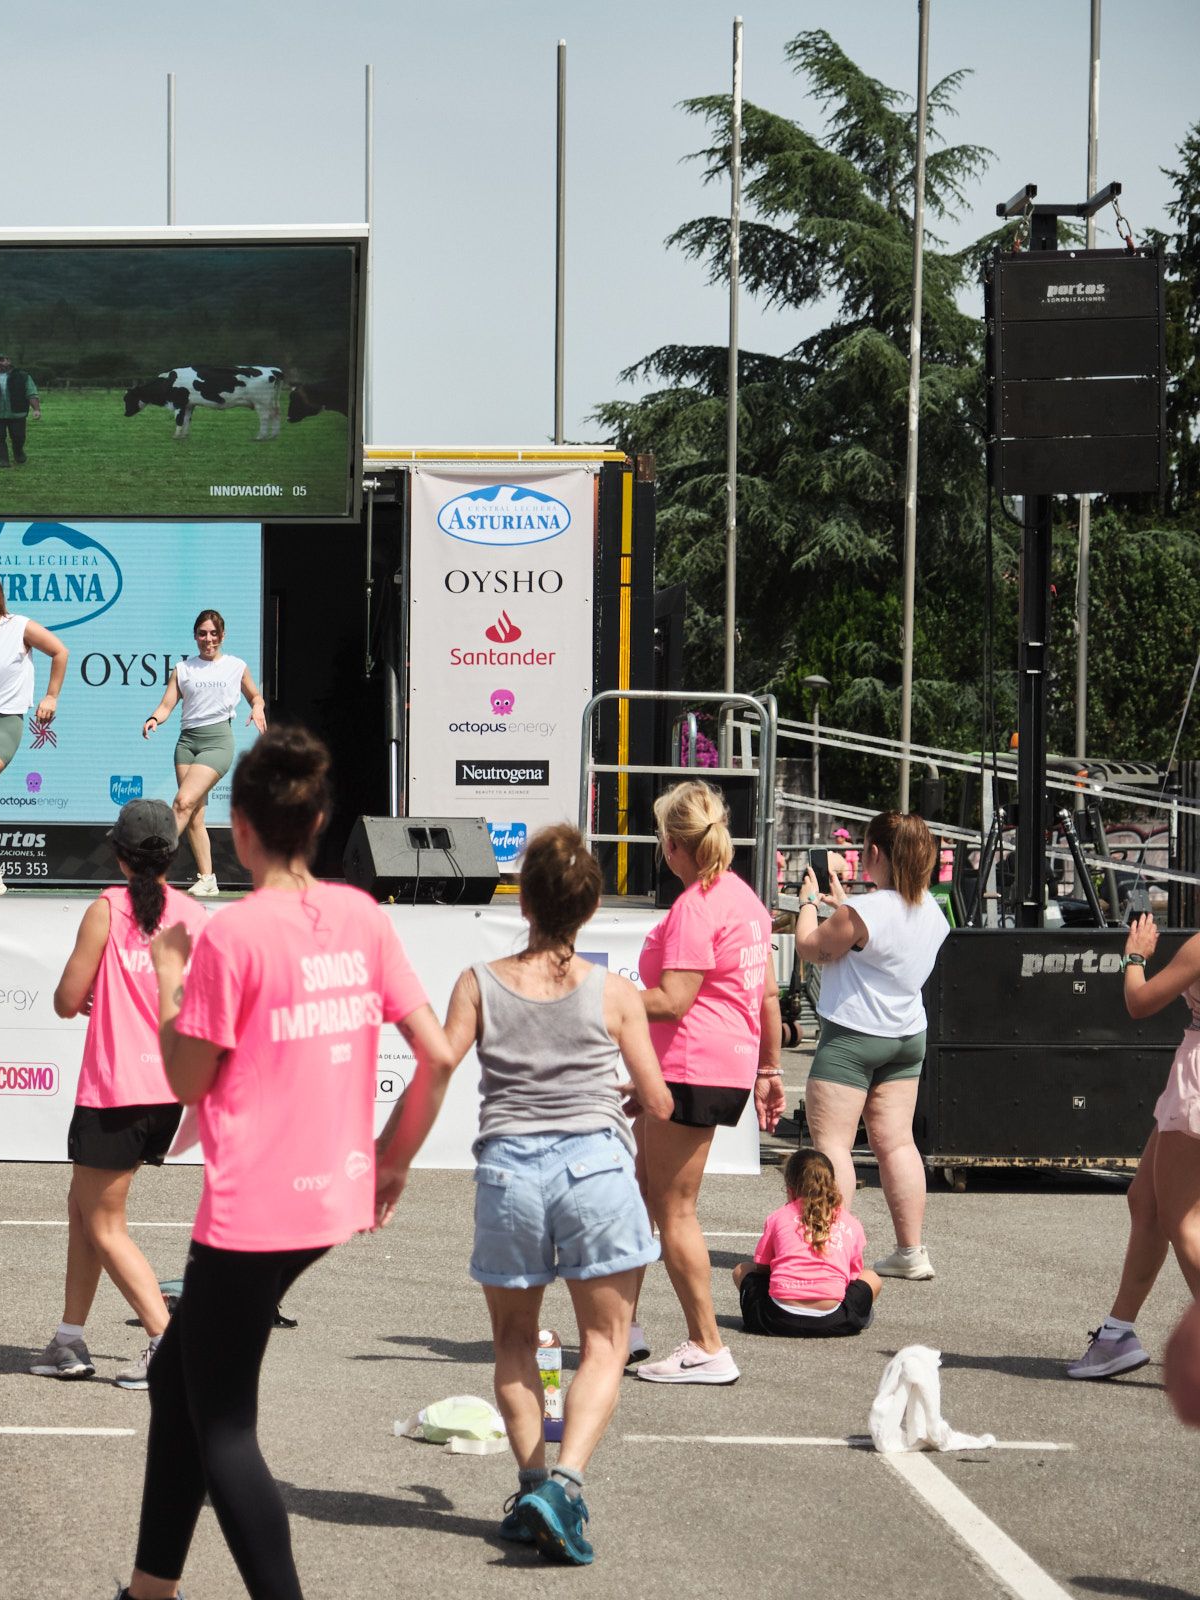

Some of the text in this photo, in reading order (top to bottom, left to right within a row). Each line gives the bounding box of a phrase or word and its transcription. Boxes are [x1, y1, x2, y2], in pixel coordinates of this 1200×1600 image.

[1047, 283, 1105, 297] portos
[210, 484, 307, 496] INNOVACIÓN: 05
[28, 555, 98, 566] LECHERA
[444, 570, 563, 594] OYSHO
[450, 648, 556, 666] Santander
[80, 652, 189, 687] OYSH
[448, 721, 558, 737] octopus energy
[462, 765, 543, 783] Neutrogena
[0, 797, 69, 809] octopus energy
[25, 862, 49, 876] 353
[300, 949, 369, 992] SOMOS
[1021, 950, 1123, 977] porto
